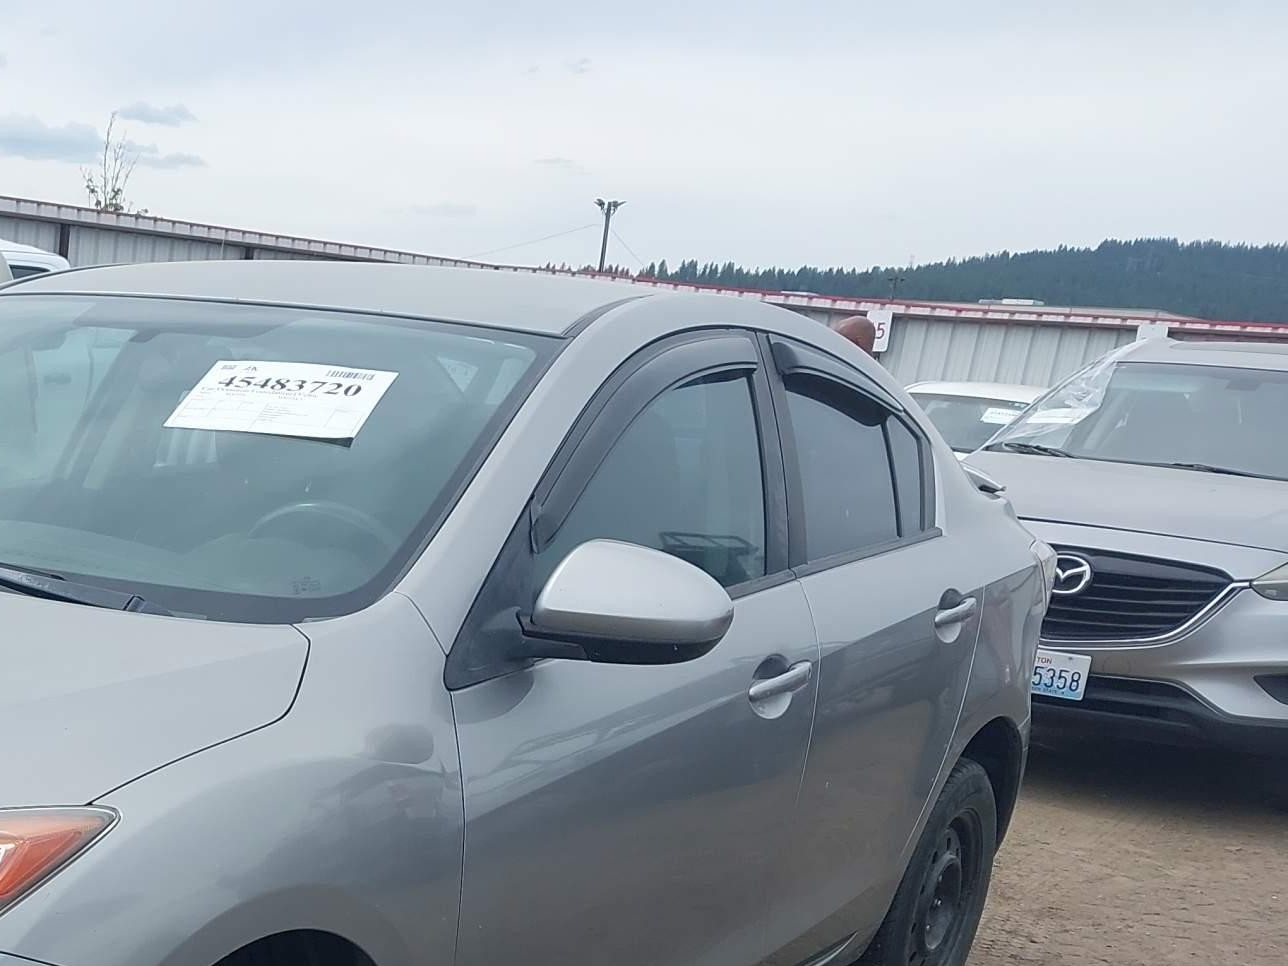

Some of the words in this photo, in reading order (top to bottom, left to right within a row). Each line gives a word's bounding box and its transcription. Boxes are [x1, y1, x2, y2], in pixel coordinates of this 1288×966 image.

[875, 322, 886, 339] 5
[218, 375, 362, 397] 45483720
[1032, 666, 1081, 692] 5358
